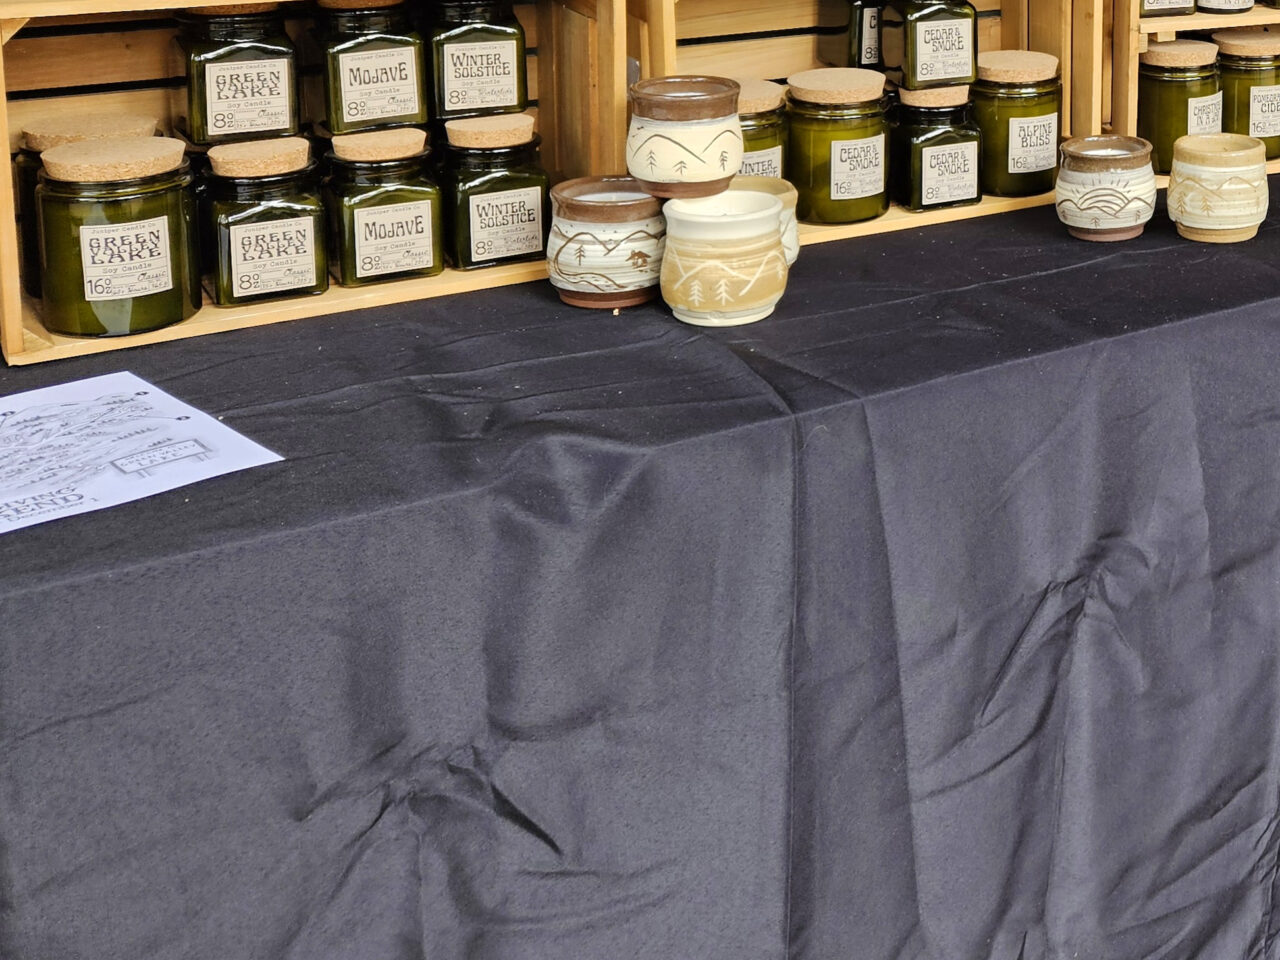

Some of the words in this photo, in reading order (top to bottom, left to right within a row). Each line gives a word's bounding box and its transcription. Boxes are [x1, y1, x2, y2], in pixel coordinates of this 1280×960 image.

[924, 28, 953, 44] CEDAR
[932, 36, 964, 52] SMOKE
[450, 53, 501, 67] WINTER
[216, 71, 280, 85] GREEN
[349, 62, 408, 86] MOJAVE
[454, 62, 510, 78] SOLSTICE
[216, 82, 280, 91] VALLEY
[217, 88, 280, 100] LAKE
[1018, 122, 1053, 138] ALPINE
[1021, 134, 1050, 148] BLISS
[840, 146, 871, 163] CEDAR
[849, 152, 880, 171] SMOKE
[929, 152, 960, 169] CEDAR
[938, 160, 970, 177] SMOKE
[476, 200, 526, 219] WINTER
[479, 209, 536, 230] SOLSTICE
[122, 224, 146, 232] Candle
[364, 215, 424, 241] MOJAVE
[89, 230, 160, 248] GREEN
[241, 229, 307, 247] GREEN
[90, 241, 160, 256] VALLEY
[242, 241, 305, 253] VALLEY
[242, 245, 307, 262] LAKE
[90, 248, 161, 265] LAKE
[270, 259, 298, 267] Candle
[122, 262, 152, 272] Candle
